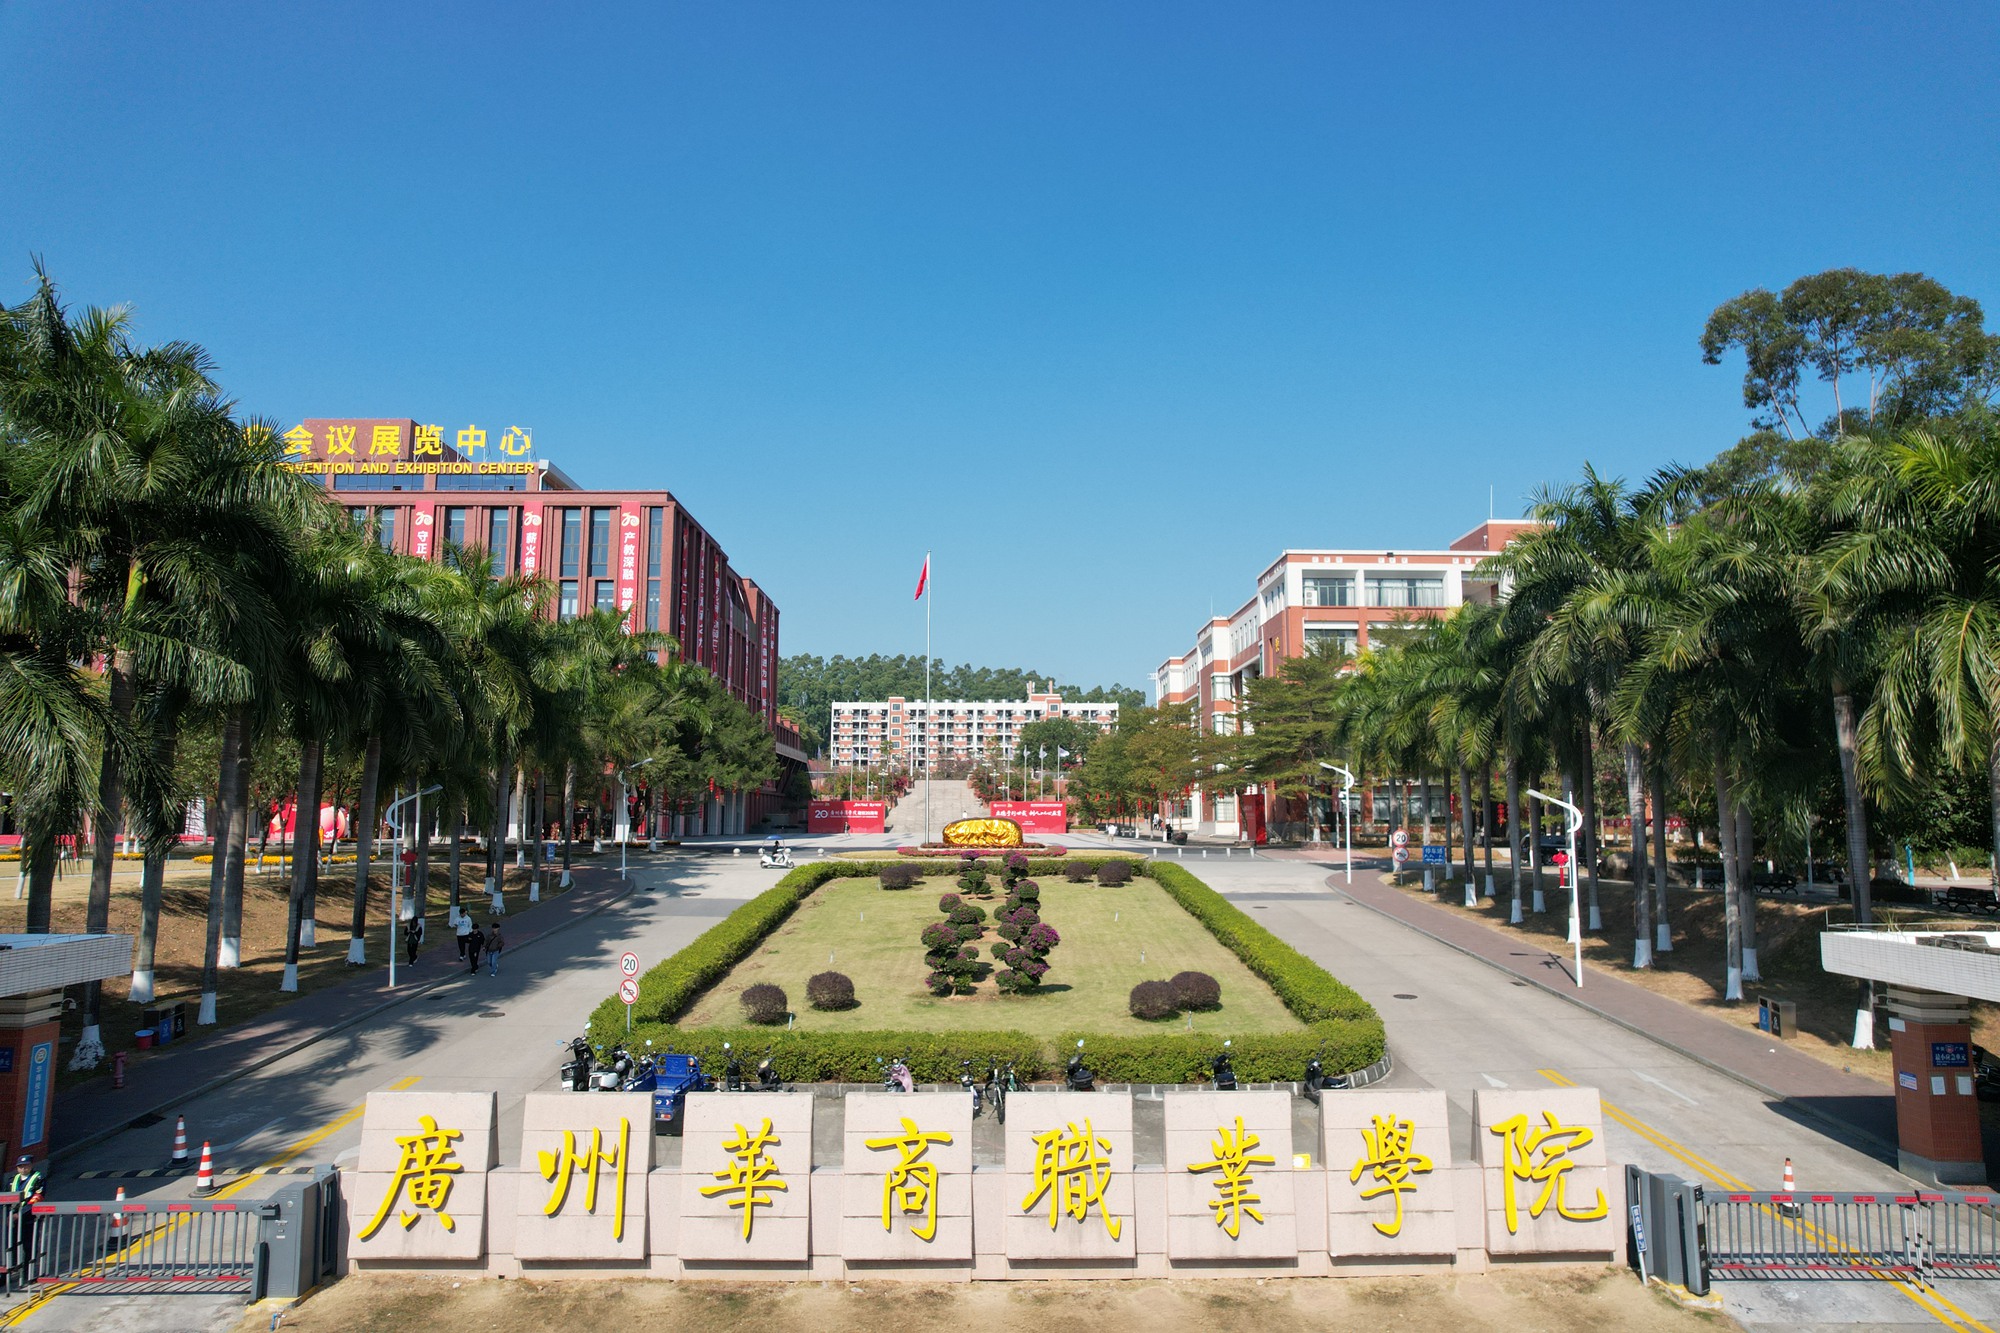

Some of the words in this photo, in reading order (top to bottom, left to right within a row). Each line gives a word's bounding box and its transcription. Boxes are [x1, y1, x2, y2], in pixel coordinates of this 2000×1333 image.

[270, 462, 354, 474] NVENTION
[360, 462, 390, 474] AND
[395, 462, 474, 474] EXHIBITION
[478, 462, 535, 474] CENTER
[416, 531, 429, 562] 守正
[814, 809, 829, 819] 20
[1396, 834, 1407, 843] 20
[623, 958, 636, 971] 20
[357, 1111, 1609, 1241] 廣州華商職業學院
